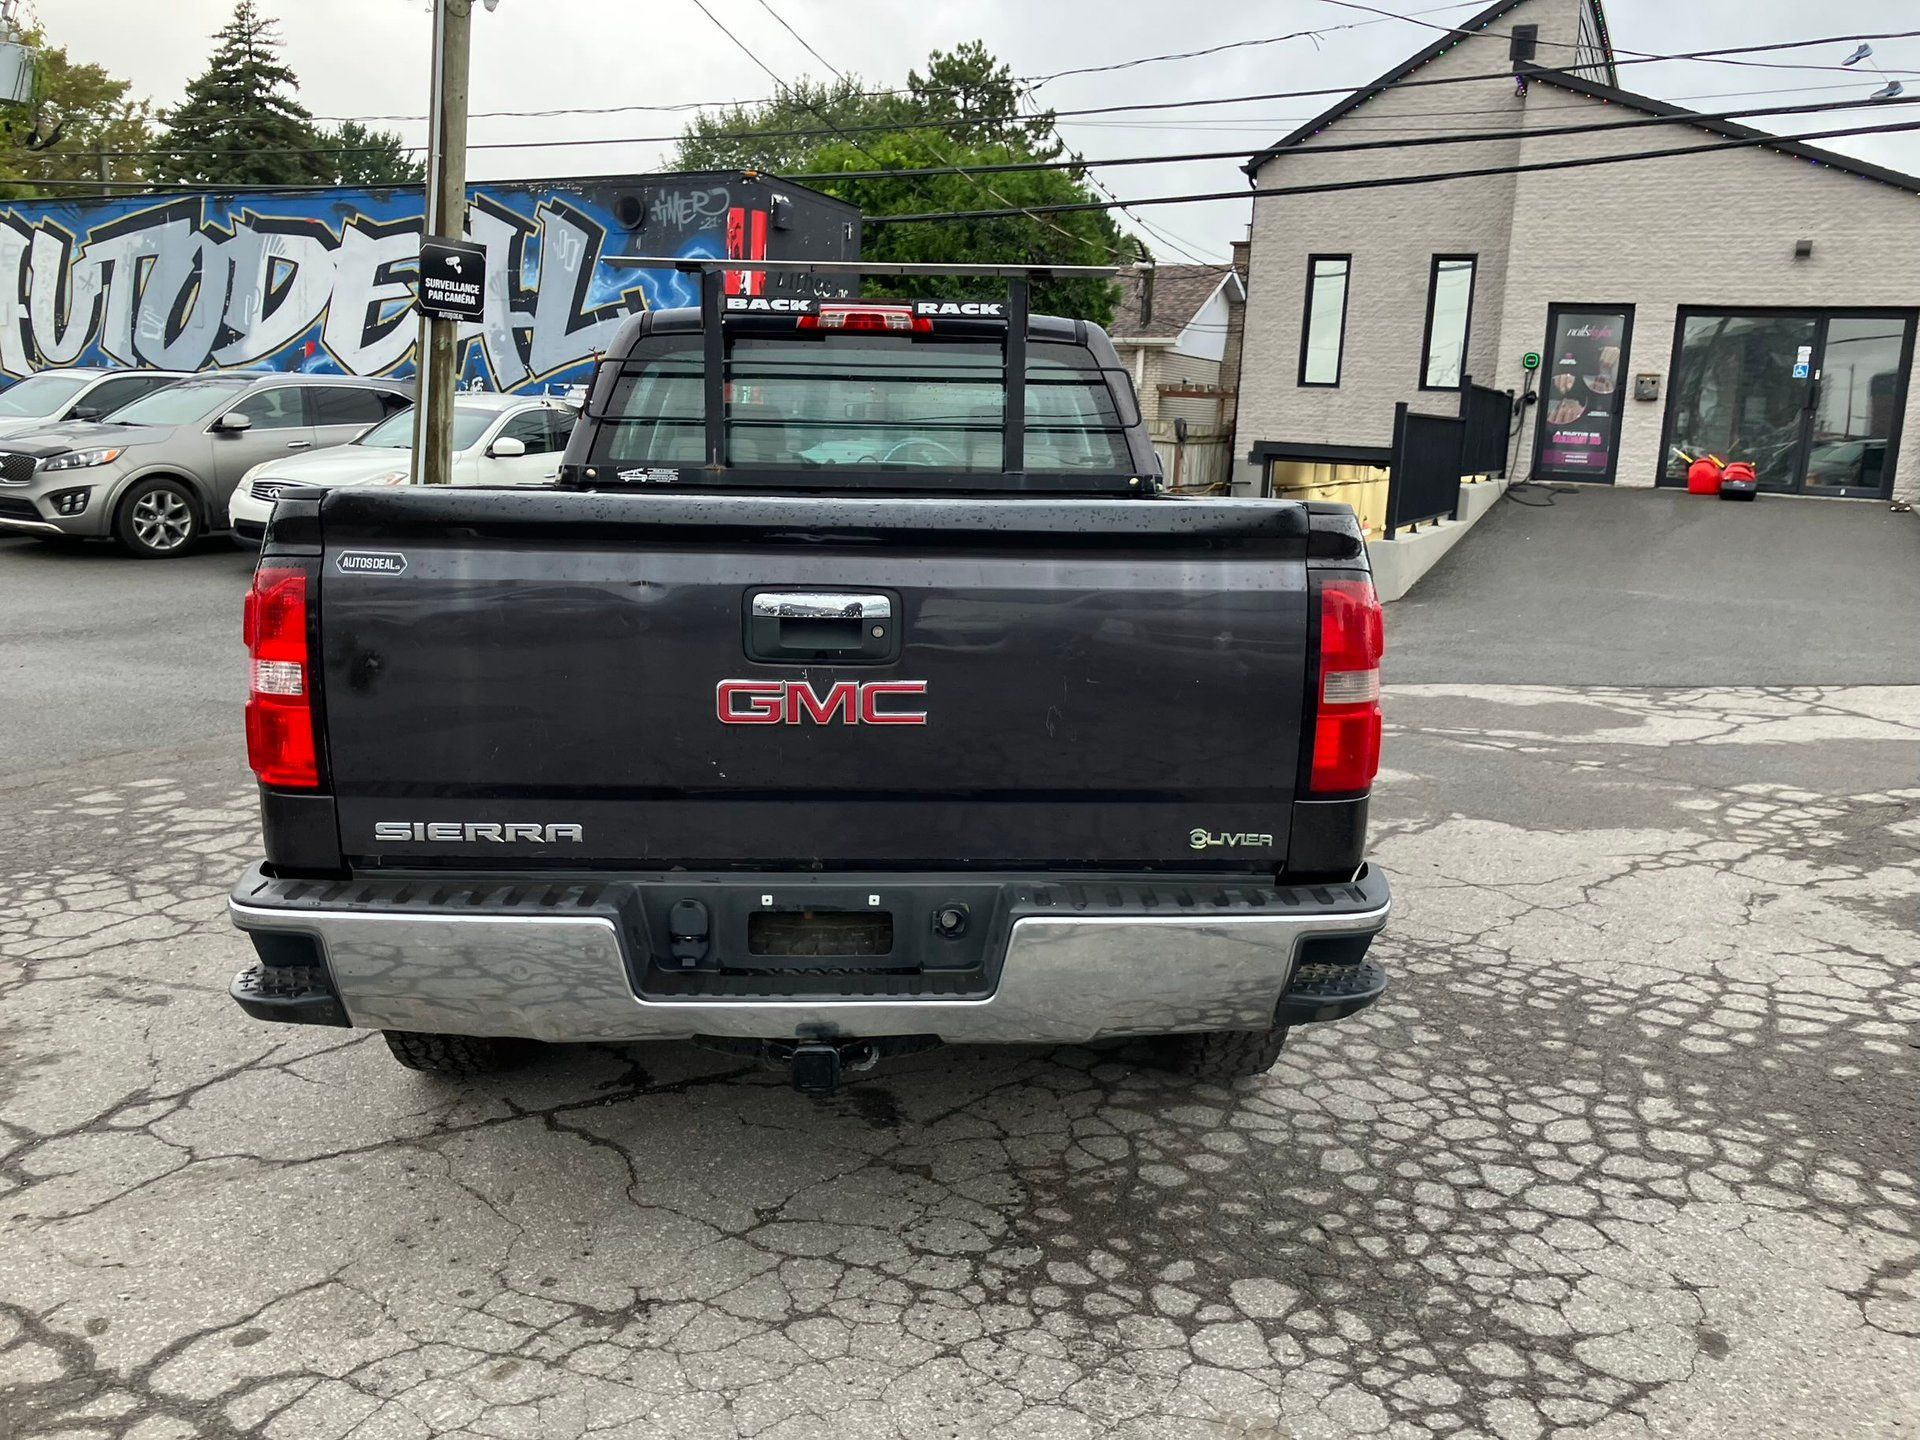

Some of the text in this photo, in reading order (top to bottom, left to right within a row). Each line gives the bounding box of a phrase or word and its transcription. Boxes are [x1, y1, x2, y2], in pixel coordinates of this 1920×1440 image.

[425, 277, 480, 294] SURVEILLANCE
[428, 289, 476, 305] PAR CAMÉRA
[727, 298, 1001, 315] BACK RACK
[716, 679, 928, 725] GMC
[375, 822, 583, 843] SIERRA
[1189, 828, 1273, 849] OLIVIER
